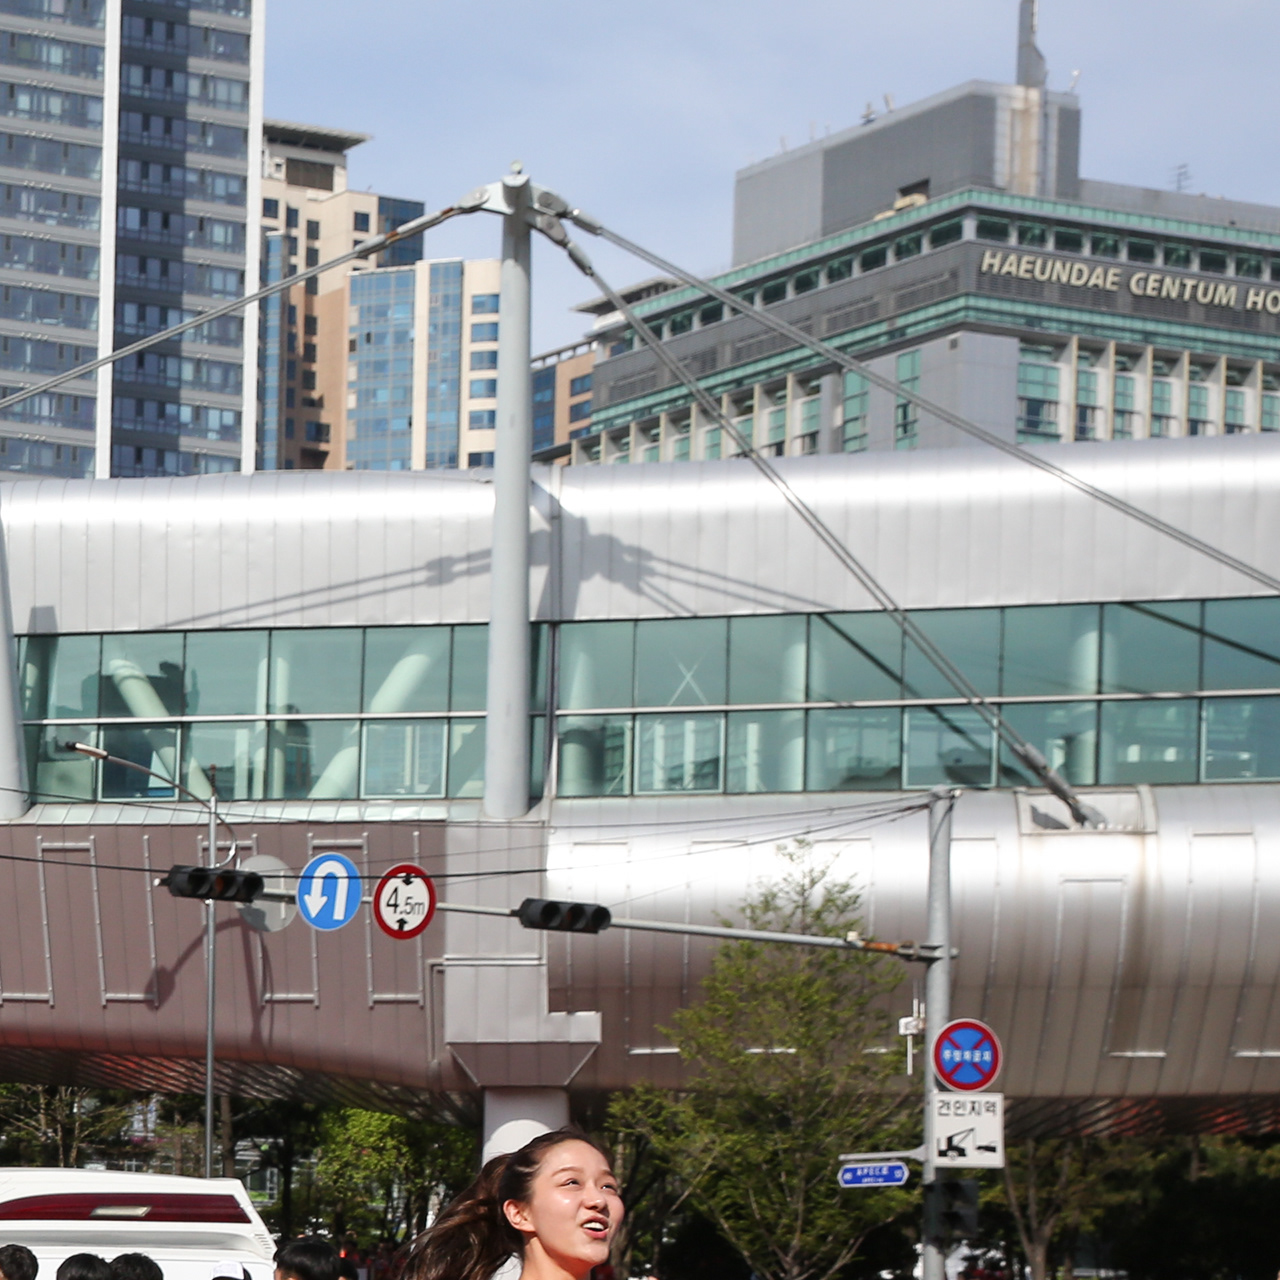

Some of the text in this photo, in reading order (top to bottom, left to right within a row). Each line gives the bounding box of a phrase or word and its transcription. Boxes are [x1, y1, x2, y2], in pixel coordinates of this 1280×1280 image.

[981, 250, 1122, 292] HAEUNDAE
[1129, 271, 1238, 307] CENTUM
[385, 885, 426, 917] 4.5m
[937, 1101, 998, 1117] 견인지역
